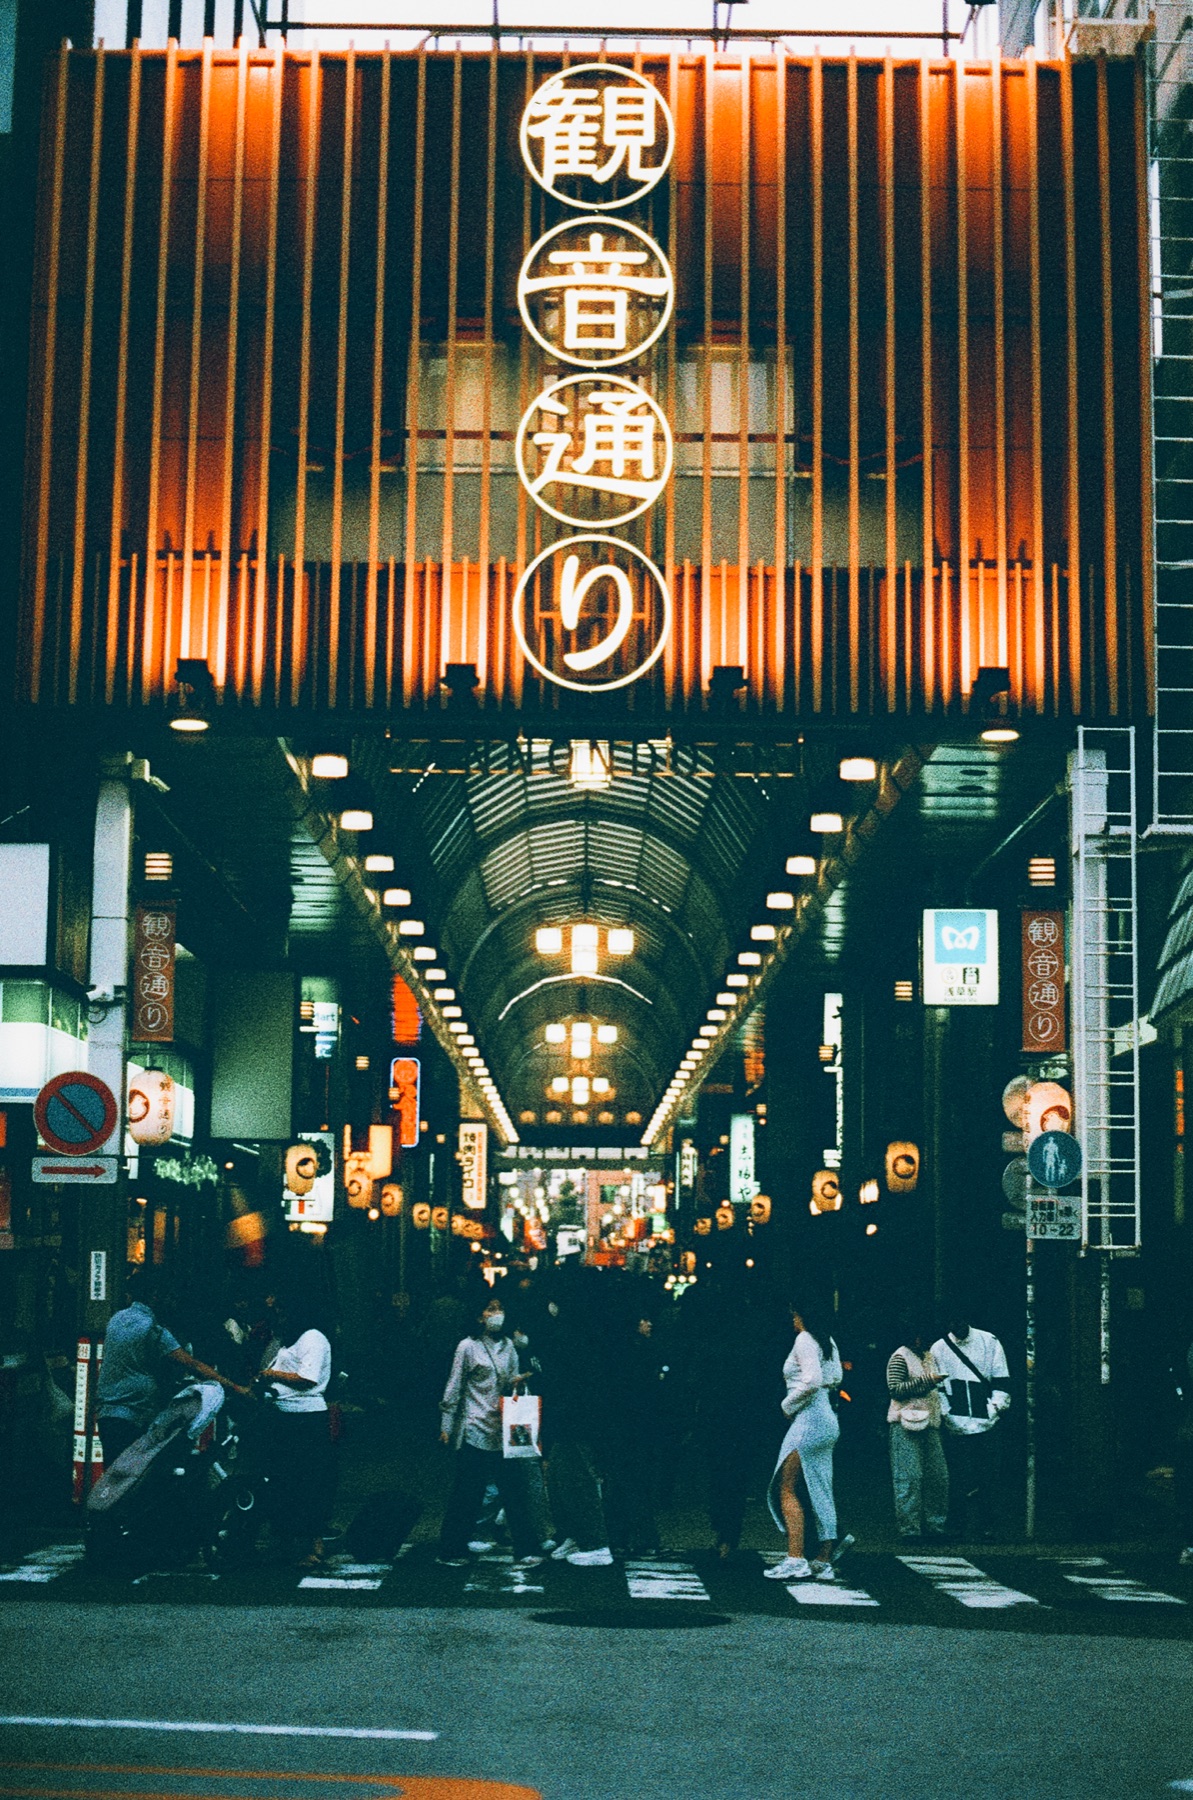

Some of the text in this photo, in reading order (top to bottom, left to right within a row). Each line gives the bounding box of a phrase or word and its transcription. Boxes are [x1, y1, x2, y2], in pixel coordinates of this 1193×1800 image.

[522, 80, 670, 673] 観音通り
[141, 914, 170, 1029] 観音通り
[1028, 920, 1059, 1039] 観音通り
